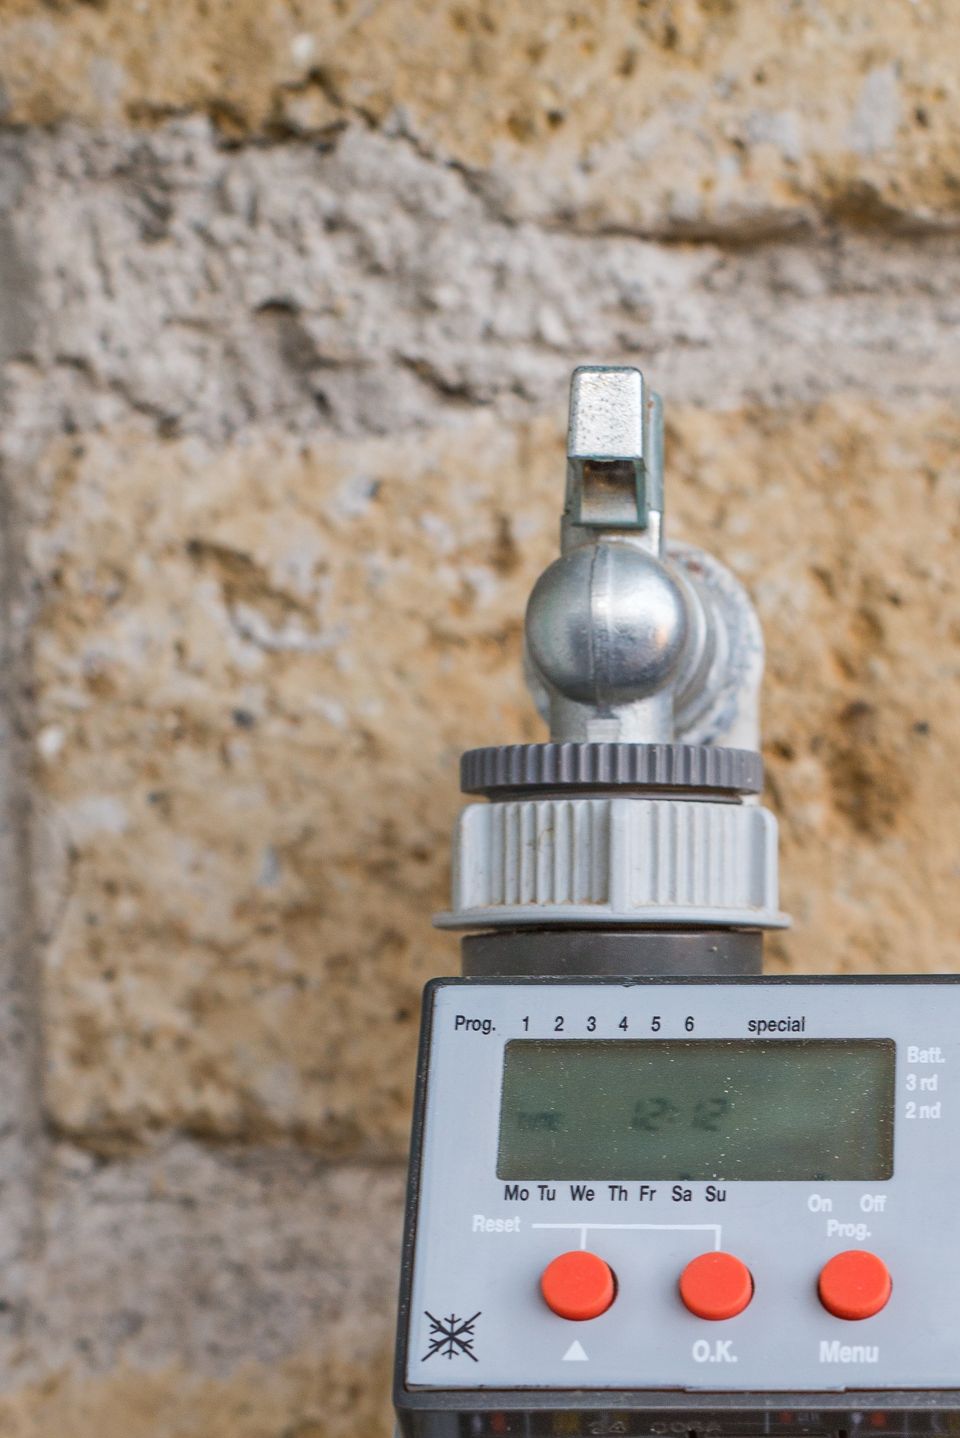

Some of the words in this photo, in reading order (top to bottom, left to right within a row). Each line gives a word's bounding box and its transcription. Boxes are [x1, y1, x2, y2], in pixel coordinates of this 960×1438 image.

[454, 1016, 497, 1036] Prog.
[522, 1016, 529, 1032] 1
[554, 1016, 564, 1032] 2
[586, 1016, 597, 1032] 3
[618, 1016, 629, 1032] 4
[651, 1016, 661, 1032] 5
[684, 1016, 695, 1032] 6
[747, 1016, 806, 1036] special
[907, 1046, 946, 1064] Batt.
[504, 1185, 530, 1202] Mo
[538, 1185, 556, 1202] Tu
[570, 1185, 595, 1202] We
[608, 1185, 628, 1202] Th
[639, 1185, 656, 1202] Fr
[671, 1185, 693, 1202] Sa
[705, 1185, 727, 1202] Su
[808, 1194, 833, 1212] On
[860, 1194, 887, 1212] Off
[472, 1215, 521, 1233] Reset
[827, 1219, 871, 1240] Prog.
[692, 1340, 738, 1362] O.K.
[819, 1341, 879, 1363] Menu
